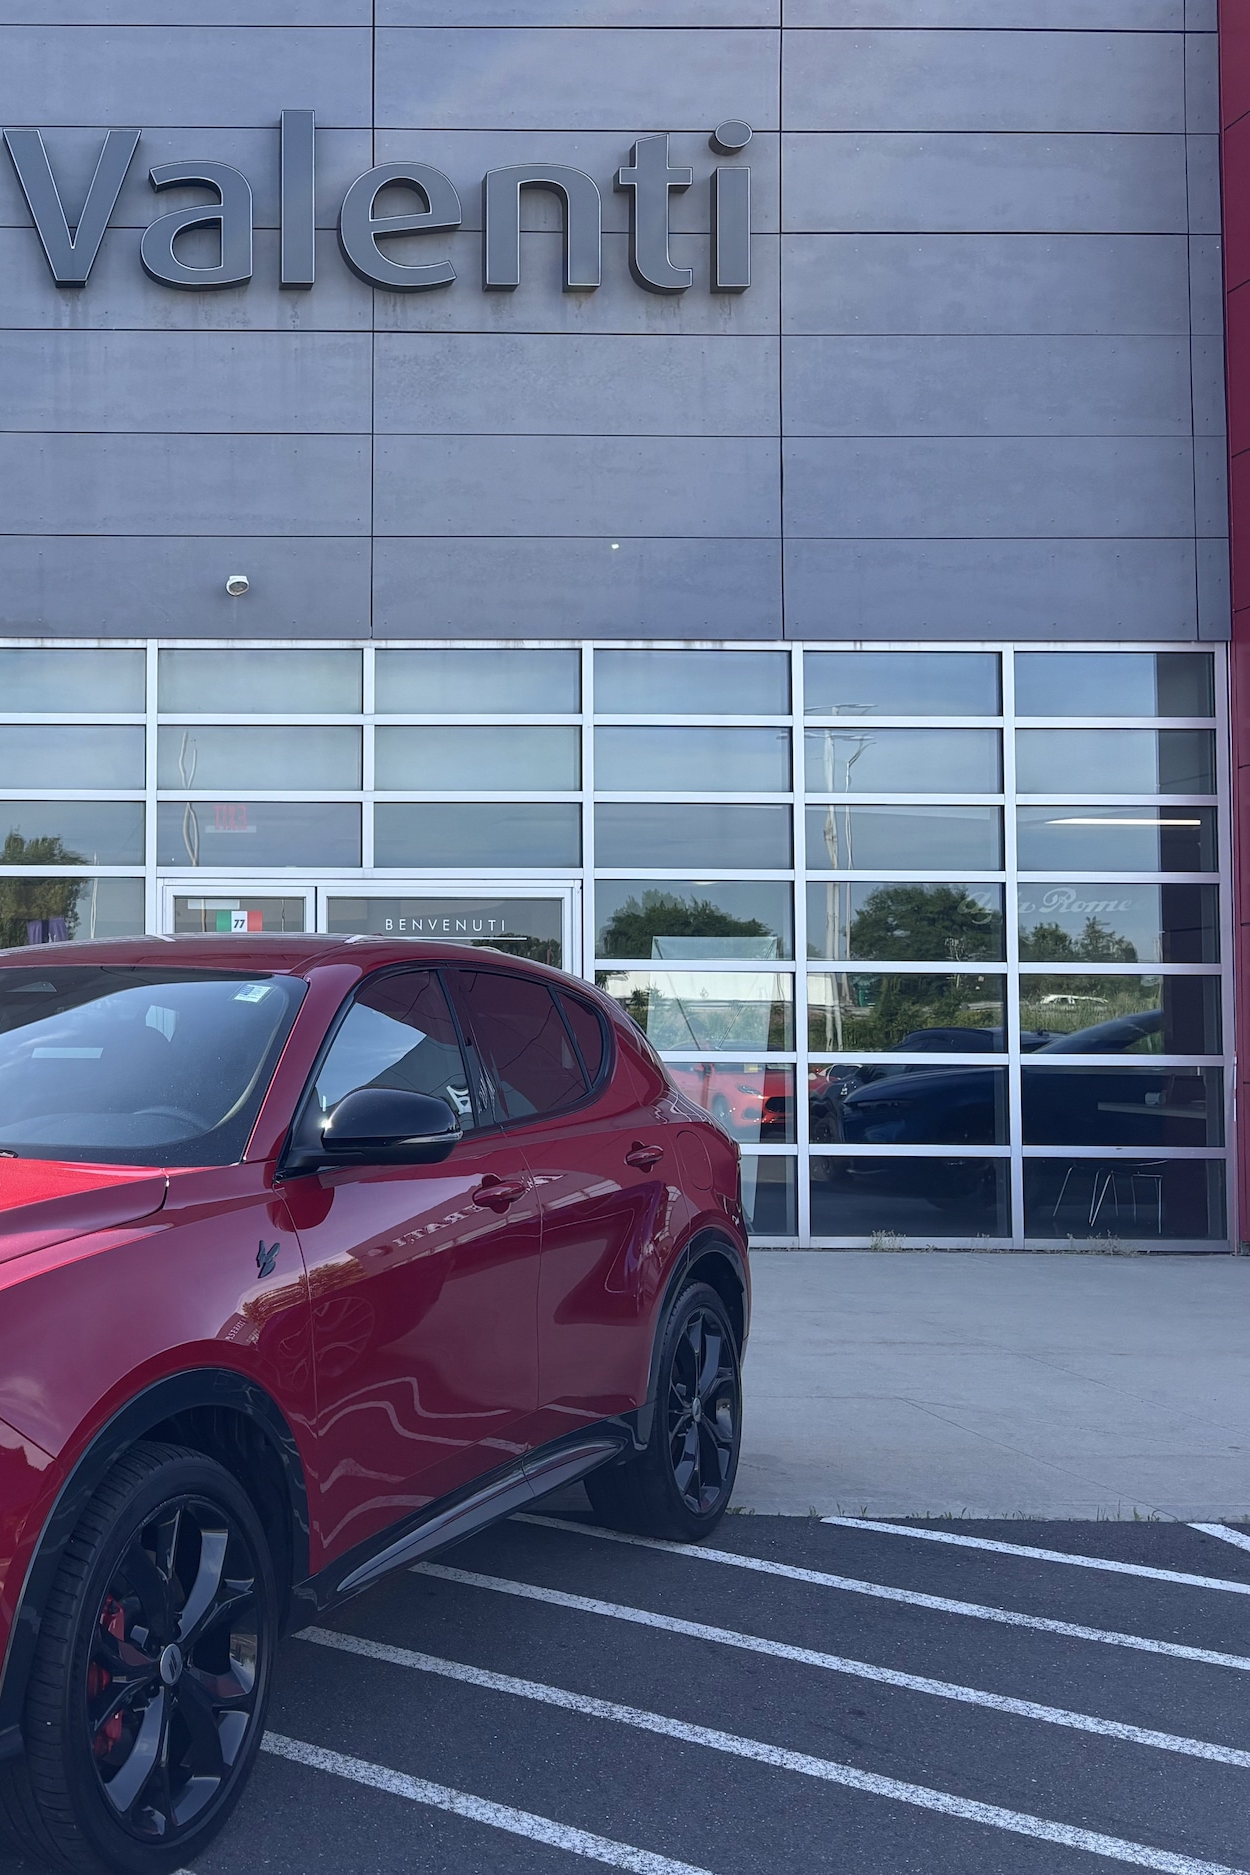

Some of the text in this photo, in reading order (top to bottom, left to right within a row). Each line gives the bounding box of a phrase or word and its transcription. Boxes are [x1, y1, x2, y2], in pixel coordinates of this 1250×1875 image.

[2, 109, 753, 294] Valenti
[1038, 887, 1136, 914] Rome
[233, 919, 246, 929] 77
[385, 918, 506, 932] BENVENUTI
